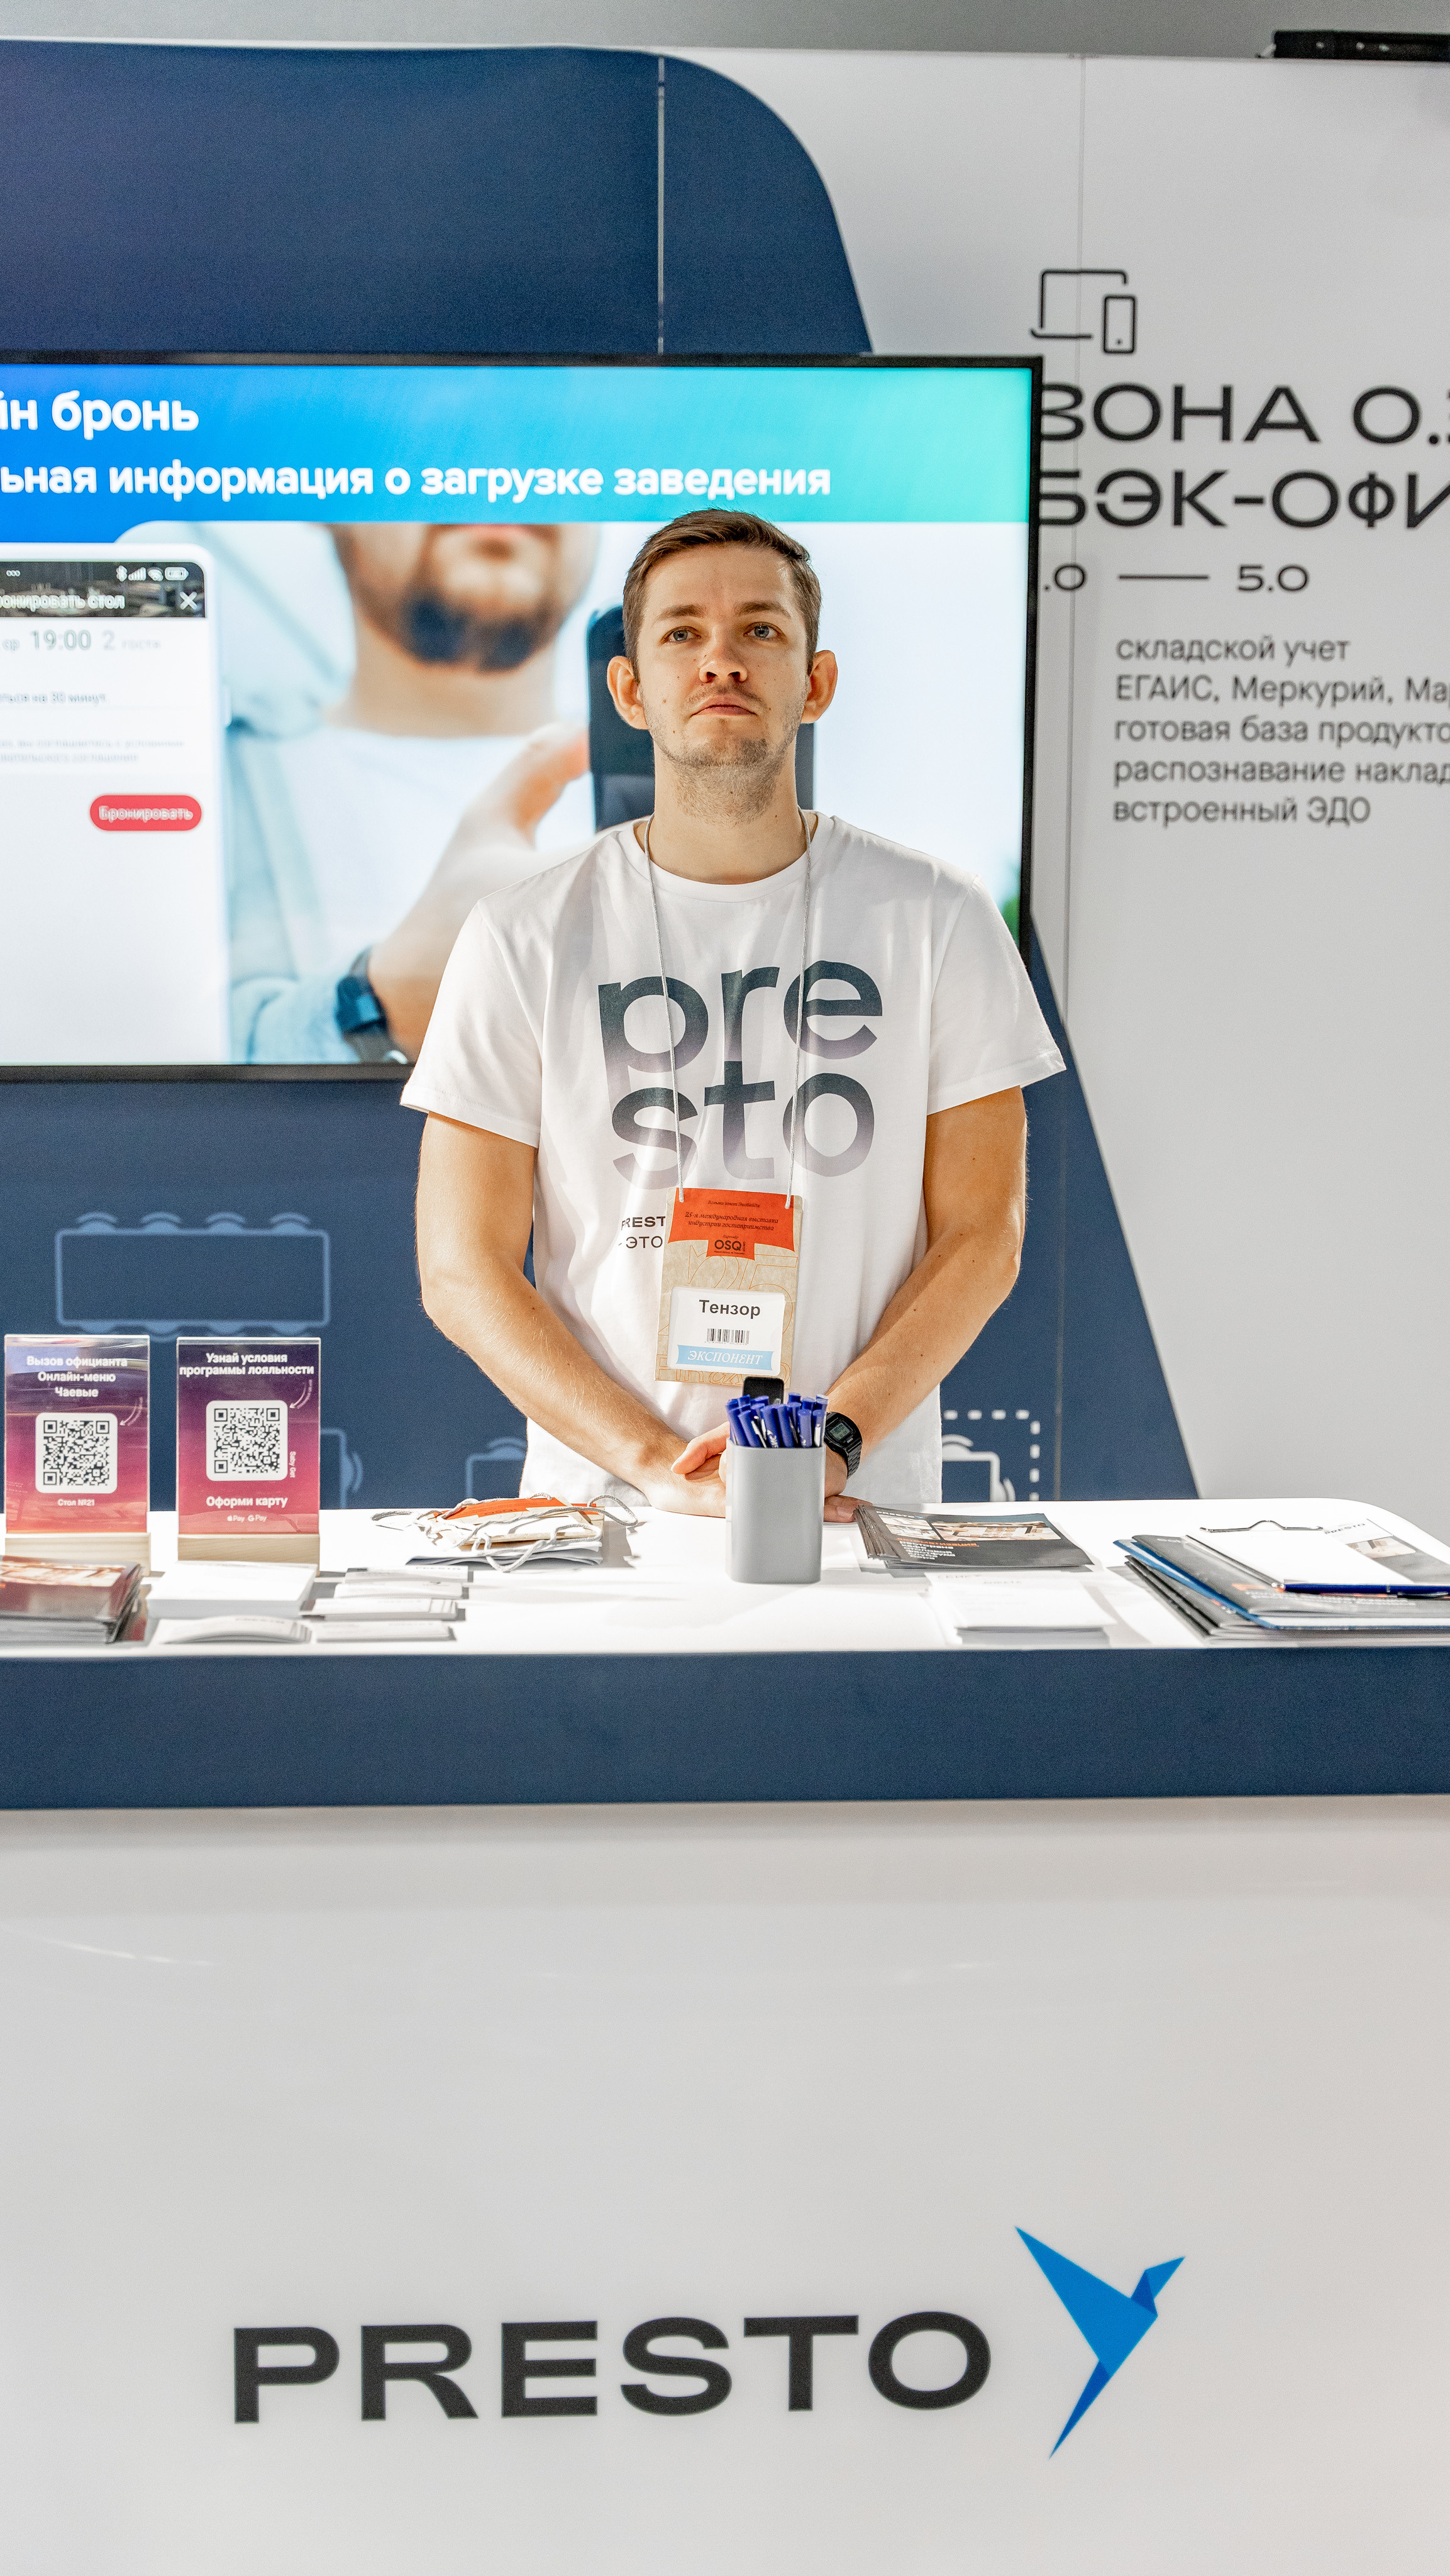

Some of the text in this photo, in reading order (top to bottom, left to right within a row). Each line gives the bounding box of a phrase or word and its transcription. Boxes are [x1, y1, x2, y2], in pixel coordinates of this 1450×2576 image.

[52, 390, 199, 440] бронь
[1041, 382, 1322, 443] ЗОНА
[1, 458, 831, 503] ьная информация о загрузке заведения
[1237, 564, 1310, 592] 5.0
[0, 595, 126, 612] онировать стол
[31, 629, 92, 650] 19:00
[102, 630, 116, 650] 2
[1115, 635, 1350, 667] складской учет
[1116, 674, 1450, 708] ЕГАИС, Меркурий, Ма
[1115, 714, 1450, 749] готовая база продукто
[1114, 761, 1346, 789] распознавание
[98, 805, 194, 823] Бронировать
[1113, 796, 1371, 828] встроенный ЭДО
[598, 960, 883, 1096] pre
[611, 1061, 875, 1191] sto
[688, 1219, 774, 1231] индустрии гостеприимства
[699, 1214, 748, 1222] международная
[714, 1240, 742, 1252] OSQ
[699, 1299, 761, 1320] Тензор
[26, 1355, 128, 1369] Вызов официанта
[206, 1352, 287, 1365] Узнай условия
[687, 1350, 763, 1366] ЭКСПОНЕНТ
[38, 1371, 116, 1382] Онлайн-меню
[179, 1365, 314, 1377] программы лояльности
[55, 1387, 99, 1397] Чаевые
[57, 1499, 95, 1507] Стол №21
[206, 1496, 288, 1509] Оформи карту
[233, 2310, 993, 2425] PRESTO
